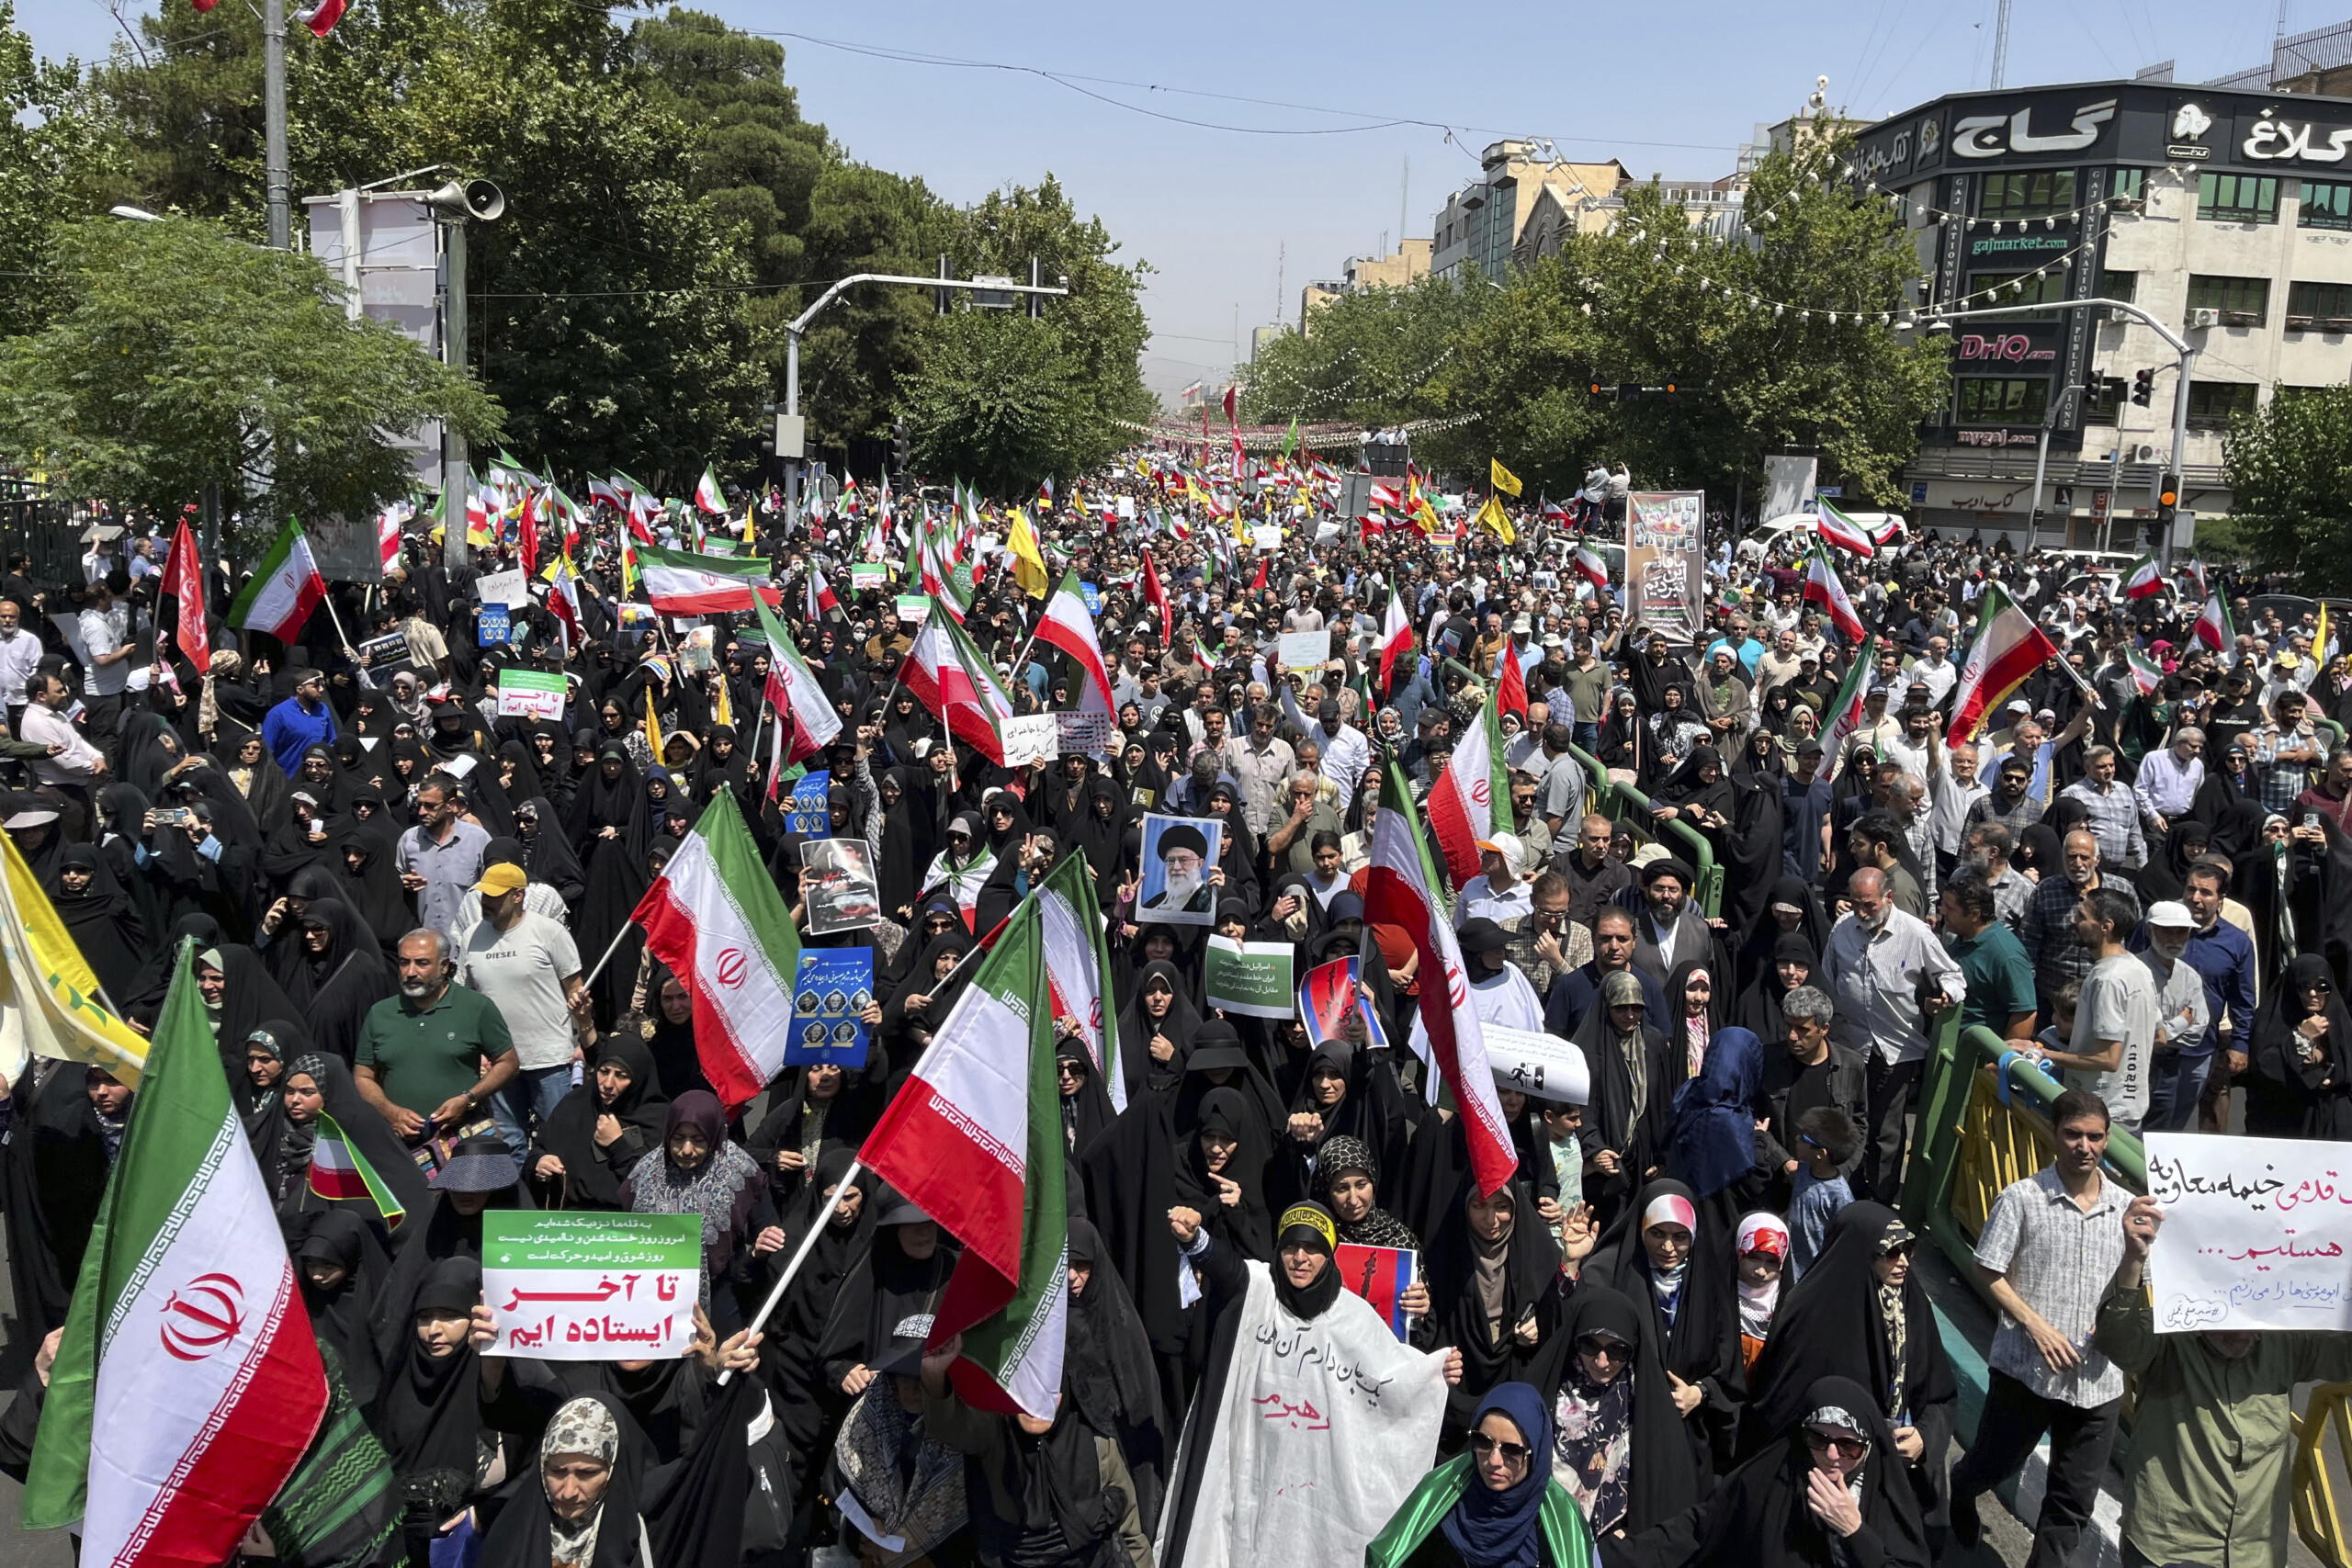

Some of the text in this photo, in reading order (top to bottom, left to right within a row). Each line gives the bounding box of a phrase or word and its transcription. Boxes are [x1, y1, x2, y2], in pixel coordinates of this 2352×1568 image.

[1952, 98, 2118, 158] گاج
[2243, 107, 2352, 162] کلاغ
[1943, 178, 1963, 306] GAJ NATIONWIDE
[1972, 237, 2068, 255] gajmarket.com
[2063, 171, 2100, 428] GAJ INTENATIONL PUBLICAIONS
[1957, 429, 2037, 446] mygaj.com
[1674, 551, 1687, 568] ما
[1663, 568, 1687, 583] این
[1644, 581, 1686, 600] نبردیم
[486, 951, 517, 960] DIESEL
[2149, 1153, 2338, 1212] قدمی خیمه معاویه
[571, 1218, 609, 1230] نزدیک
[498, 1234, 532, 1243] نیست
[606, 1234, 637, 1243] خسته
[656, 1234, 685, 1246] امروز
[621, 1252, 645, 1263] شوق
[646, 1253, 664, 1262] روز
[502, 1274, 679, 1312] تا آخر
[2272, 1281, 2284, 1300] را
[510, 1314, 673, 1349] ایستاده ایم
[1274, 1326, 1312, 1358] آن
[1297, 1342, 1335, 1379] دارم
[1336, 1361, 1363, 1395] جان
[1355, 1378, 1394, 1407] یک
[1251, 1391, 1330, 1430] رهبرم
